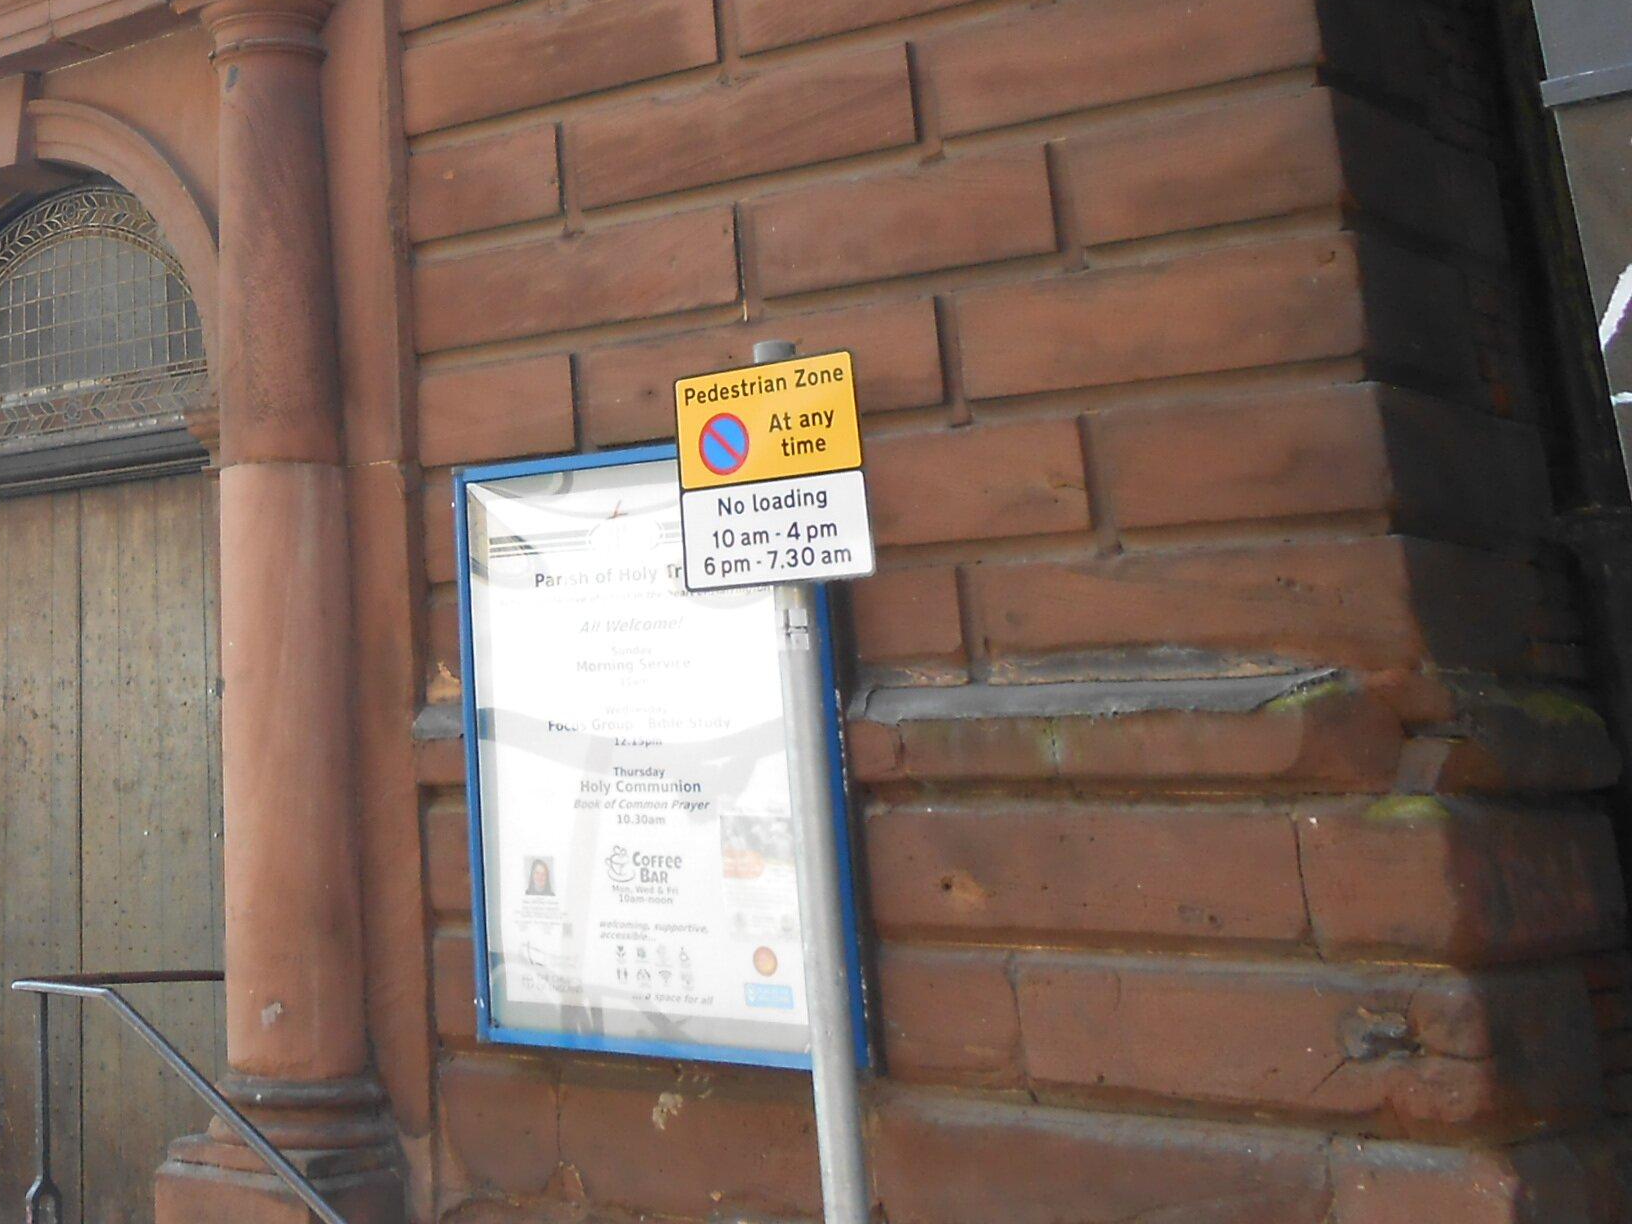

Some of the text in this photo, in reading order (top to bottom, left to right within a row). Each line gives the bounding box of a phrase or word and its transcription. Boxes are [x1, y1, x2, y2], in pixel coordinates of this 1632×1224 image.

[685, 367, 844, 406] Pedestrian Zone
[769, 409, 834, 432] At any
[781, 437, 826, 457] time
[718, 489, 827, 516] No loading
[712, 528, 735, 549] 10
[741, 529, 769, 546] am
[787, 522, 801, 540] 4
[806, 522, 838, 543] pm
[704, 557, 716, 576] 6
[721, 557, 750, 577] pm
[767, 547, 815, 570] 7.30
[821, 548, 852, 564] am
[535, 571, 589, 588] Parish
[595, 568, 612, 584] of
[619, 566, 657, 584] Holy
[579, 616, 684, 634] All Welcome!
[611, 645, 652, 657] Sunday
[576, 657, 692, 674] Morning Service
[592, 718, 635, 733] Group
[648, 717, 684, 729] Bible
[688, 716, 731, 730] Study
[613, 766, 666, 780] Thursday
[580, 779, 702, 796] Holy Communion
[573, 798, 601, 811] Book
[604, 797, 617, 811] of
[618, 798, 668, 811] Common
[671, 798, 711, 814] Prayer
[616, 813, 666, 826] 10.30am
